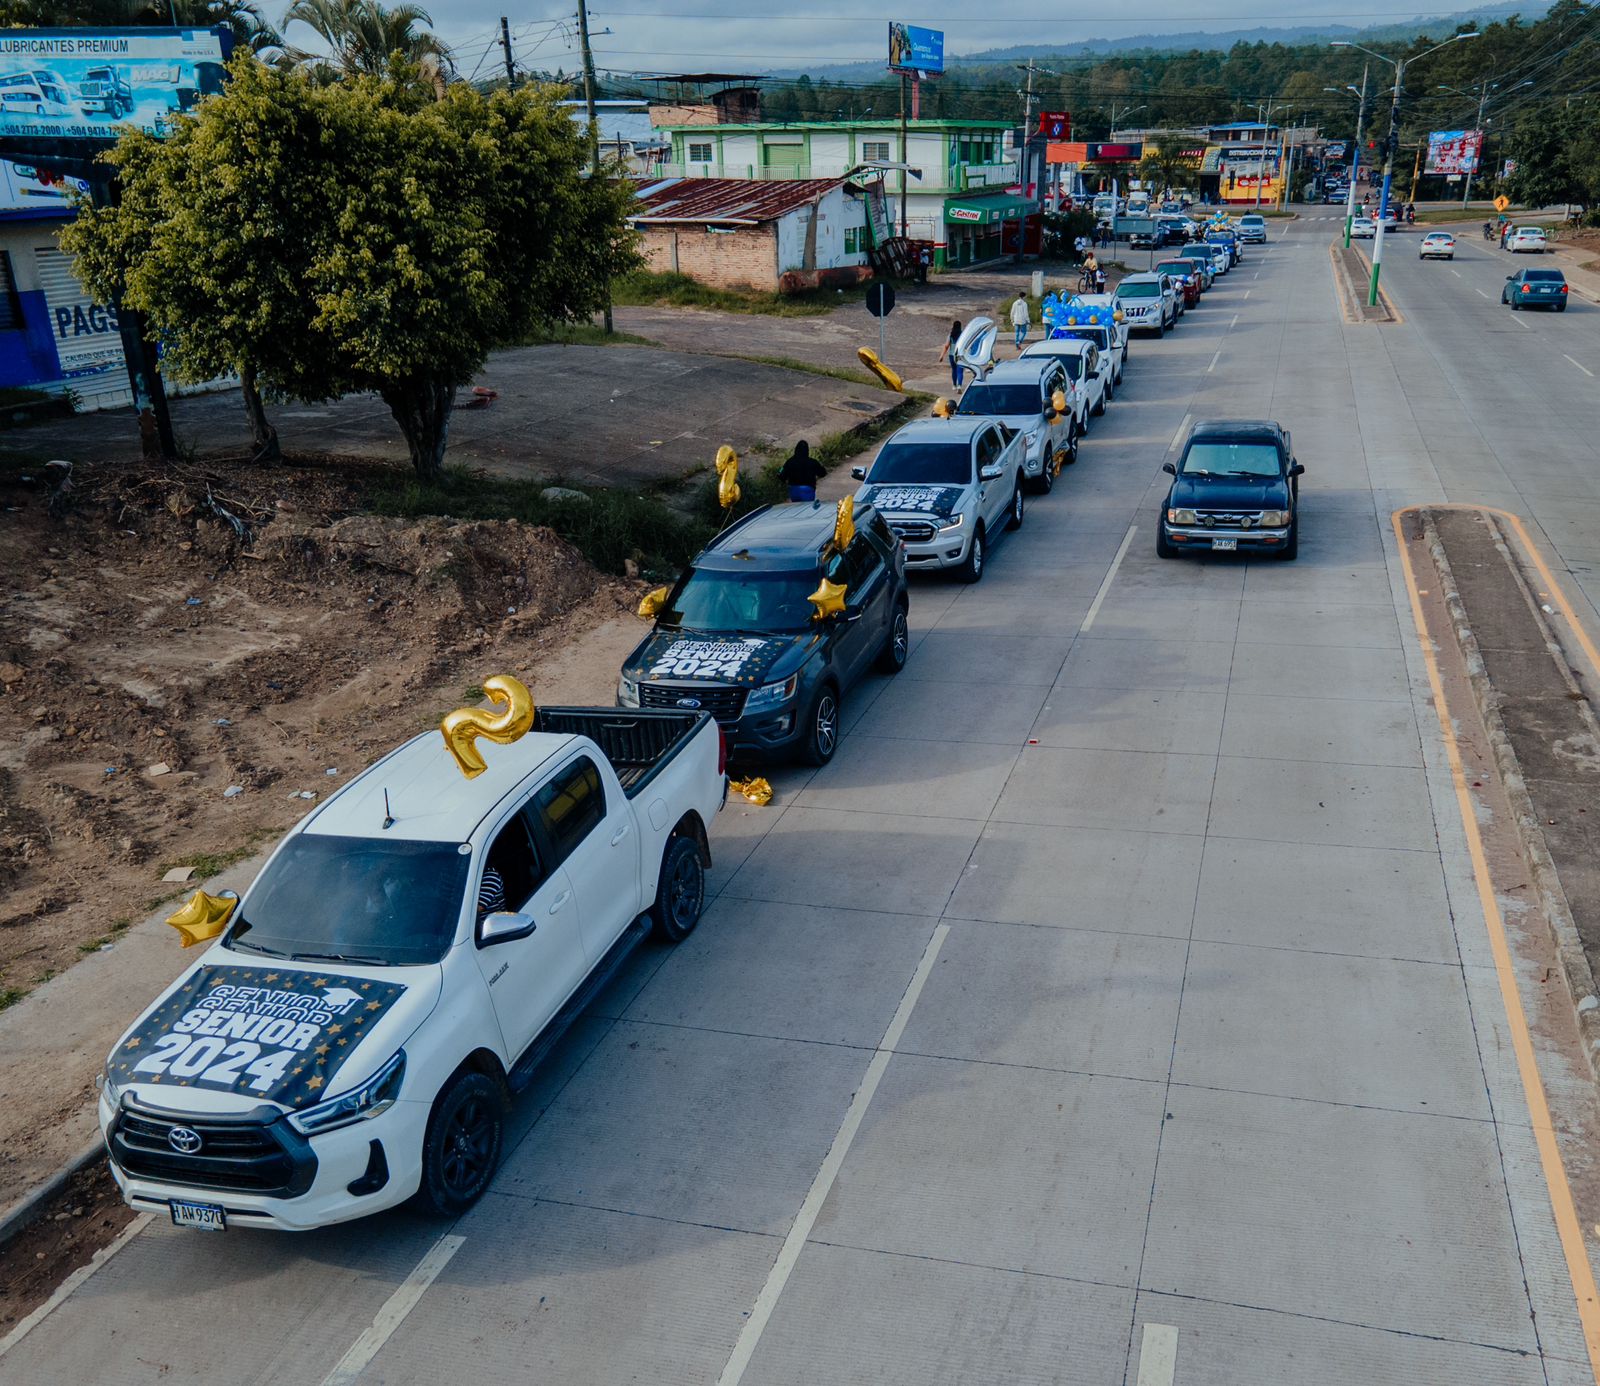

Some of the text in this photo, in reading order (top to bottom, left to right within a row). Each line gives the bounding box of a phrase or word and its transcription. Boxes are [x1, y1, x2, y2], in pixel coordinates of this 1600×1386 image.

[0, 39, 129, 53] LUBRICANTES PREMIUM
[66, 125, 87, 136] +504
[956, 210, 979, 219] Castrol
[872, 499, 934, 511] 2024
[662, 649, 751, 661] SENIOR
[649, 657, 743, 678] 2024
[173, 1008, 321, 1051] SENIOR
[132, 1032, 297, 1092] 2024
[195, 1207, 223, 1225] 9370
